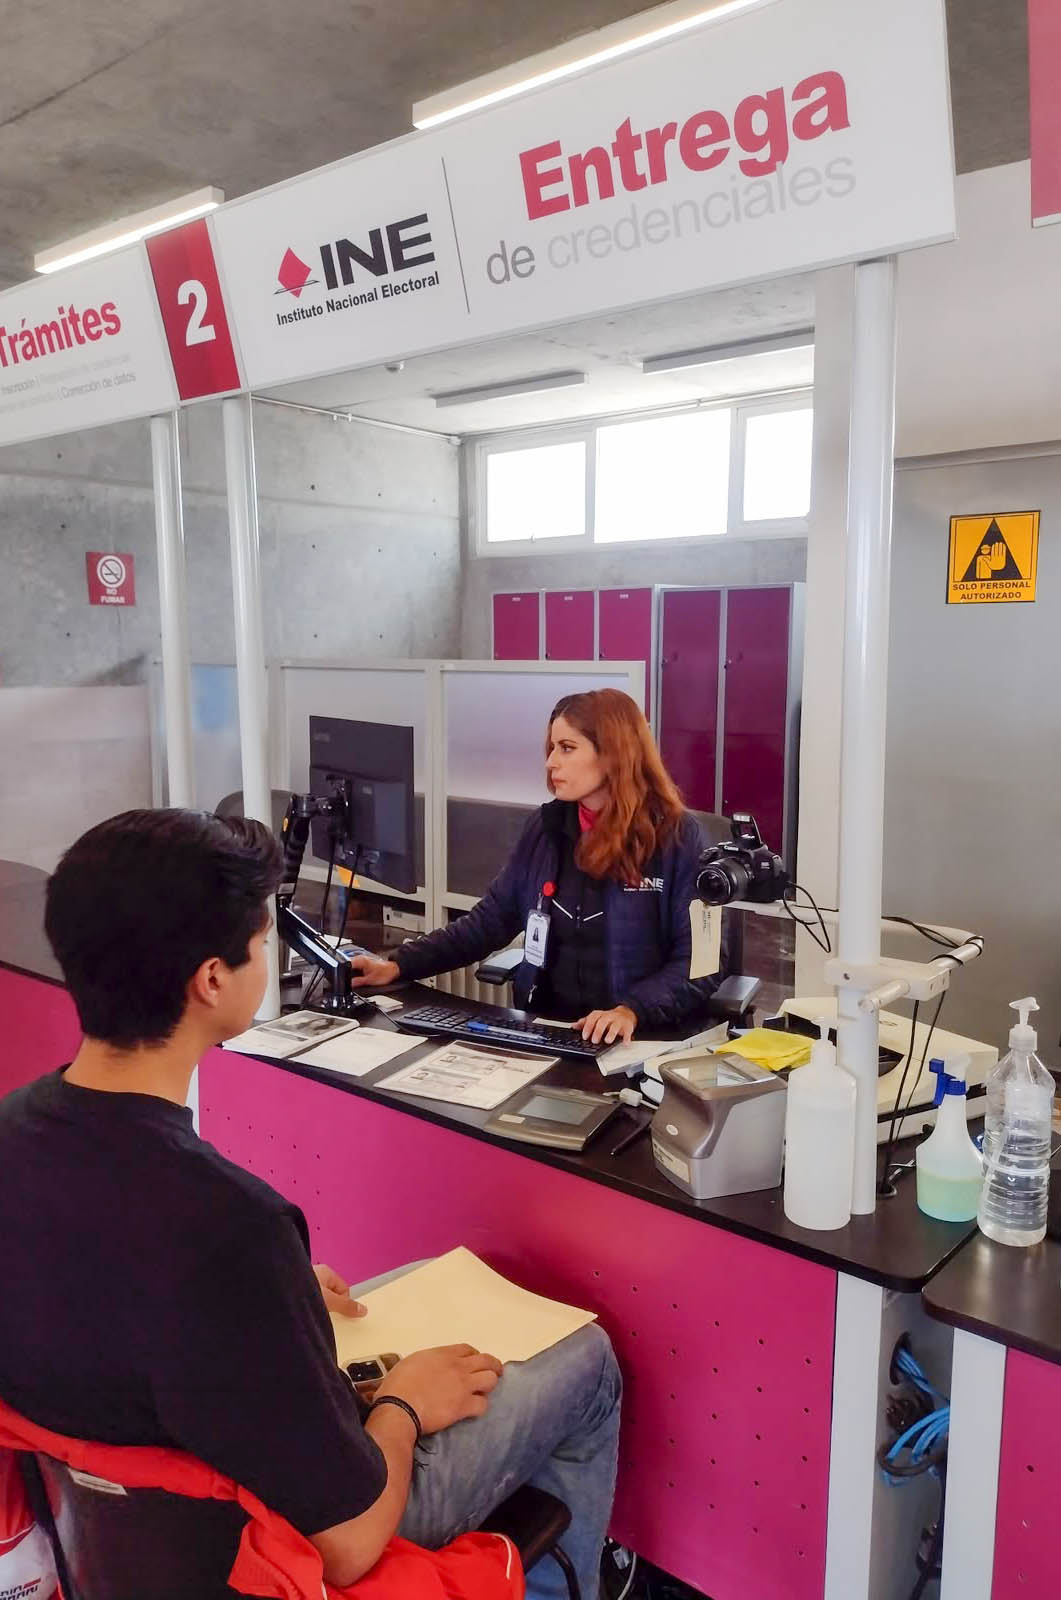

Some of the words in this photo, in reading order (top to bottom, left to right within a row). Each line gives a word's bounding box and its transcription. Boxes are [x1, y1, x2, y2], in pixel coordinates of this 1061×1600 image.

[518, 70, 851, 221] Entrega
[319, 213, 436, 290] INE
[486, 240, 536, 284] de
[546, 156, 857, 269] credenciales
[178, 280, 217, 346] 2
[276, 303, 324, 325] Instituto
[325, 287, 378, 312] Nacional
[381, 270, 440, 300] Electoral
[952, 582, 978, 591] SOLO
[980, 580, 1031, 590] PERSONAL
[960, 591, 1022, 601] AUTORIZADO
